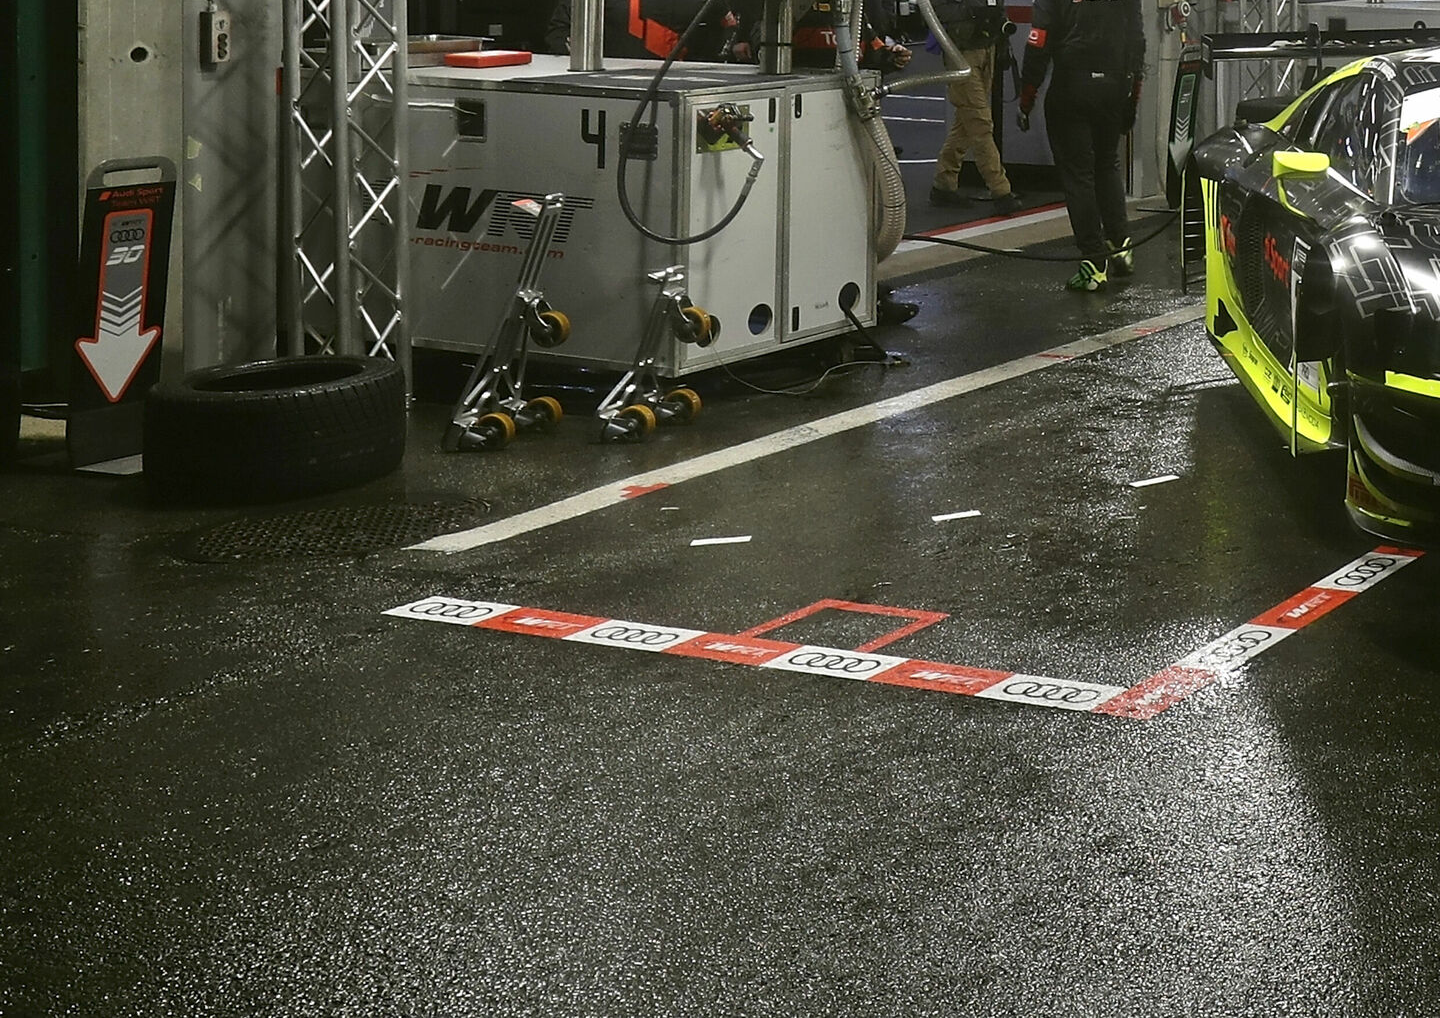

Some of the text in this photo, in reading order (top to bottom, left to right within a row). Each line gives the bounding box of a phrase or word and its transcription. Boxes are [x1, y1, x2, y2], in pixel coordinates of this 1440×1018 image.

[581, 108, 606, 169] 4
[416, 184, 595, 243] WRT
[105, 244, 145, 266] 30
[1283, 590, 1331, 620] WRT
